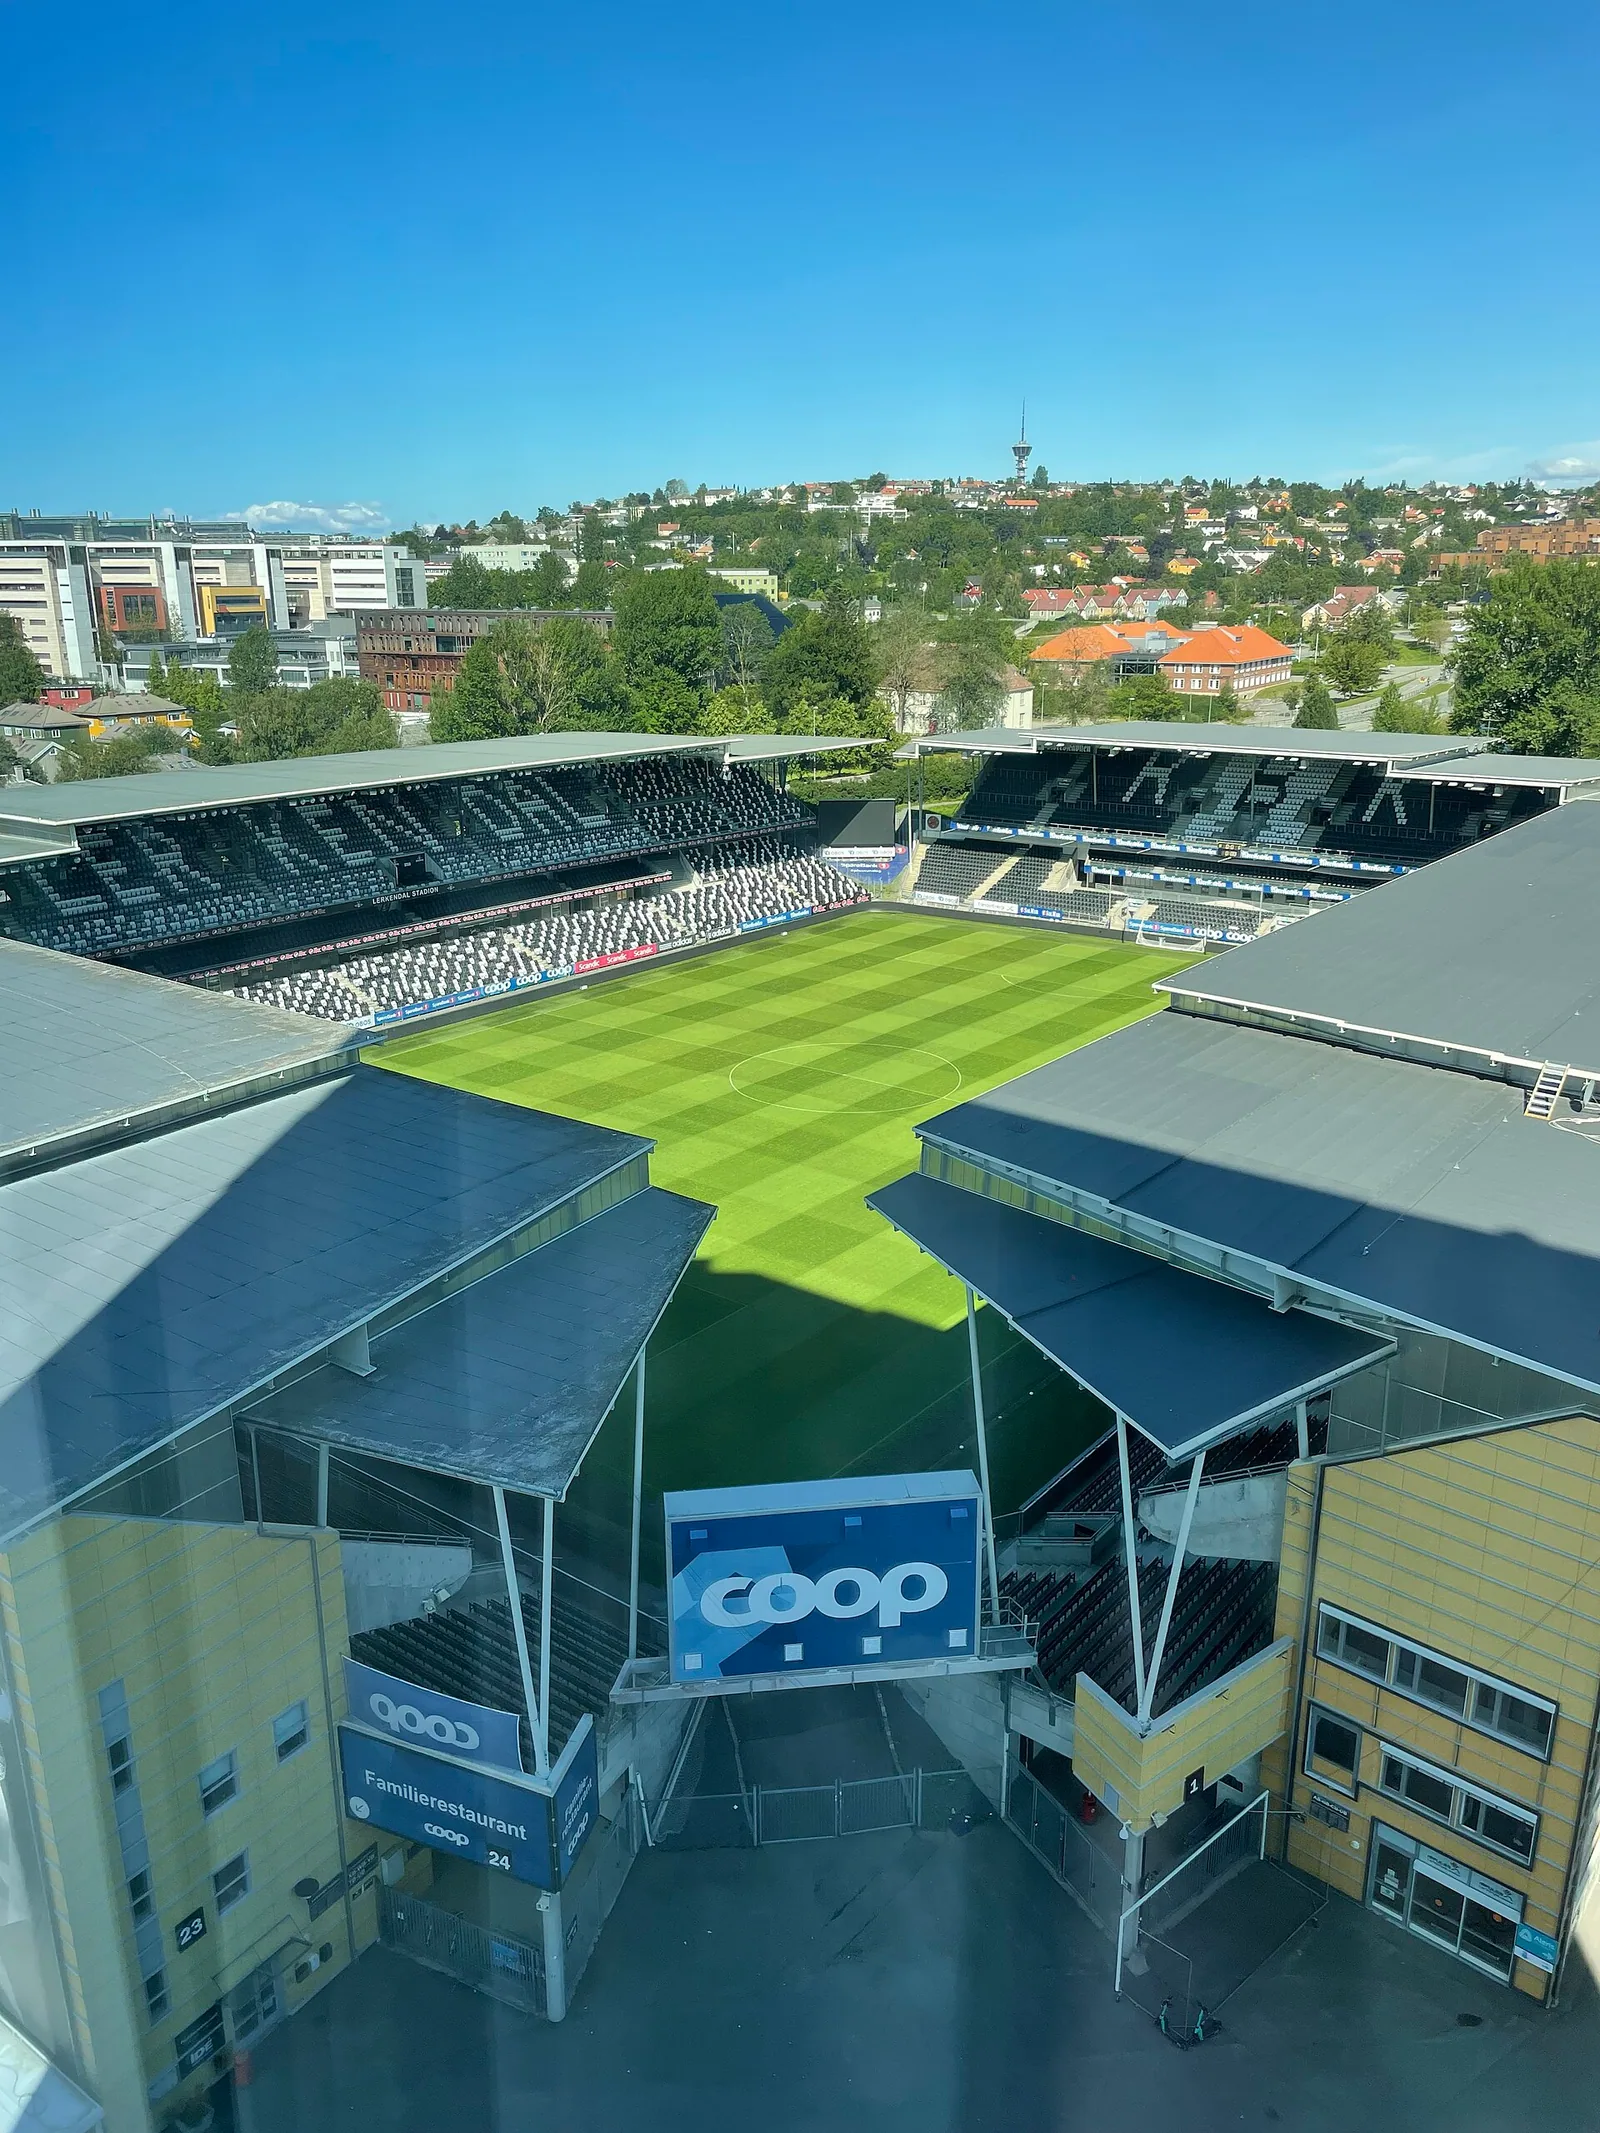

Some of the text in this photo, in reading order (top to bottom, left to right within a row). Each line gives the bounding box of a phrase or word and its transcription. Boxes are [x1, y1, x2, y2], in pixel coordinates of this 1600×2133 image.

[372, 886, 439, 905] LERKENDAL STADION
[711, 927, 732, 939] adidas
[1193, 927, 1223, 939] coop
[672, 937, 692, 948] adidas
[606, 952, 627, 964] Scandic
[633, 945, 653, 957] Scandic
[546, 963, 573, 978] coop
[579, 959, 600, 970] Scandic
[484, 978, 511, 995] coop
[516, 971, 542, 986] coop
[700, 1561, 948, 1628] coop
[1189, 1778, 1199, 1794] 1
[364, 1769, 528, 1841] Familierestaurant
[423, 1822, 470, 1846] coop
[567, 1812, 589, 1856] coop
[488, 1850, 511, 1871] 24
[179, 1917, 203, 1946] 23
